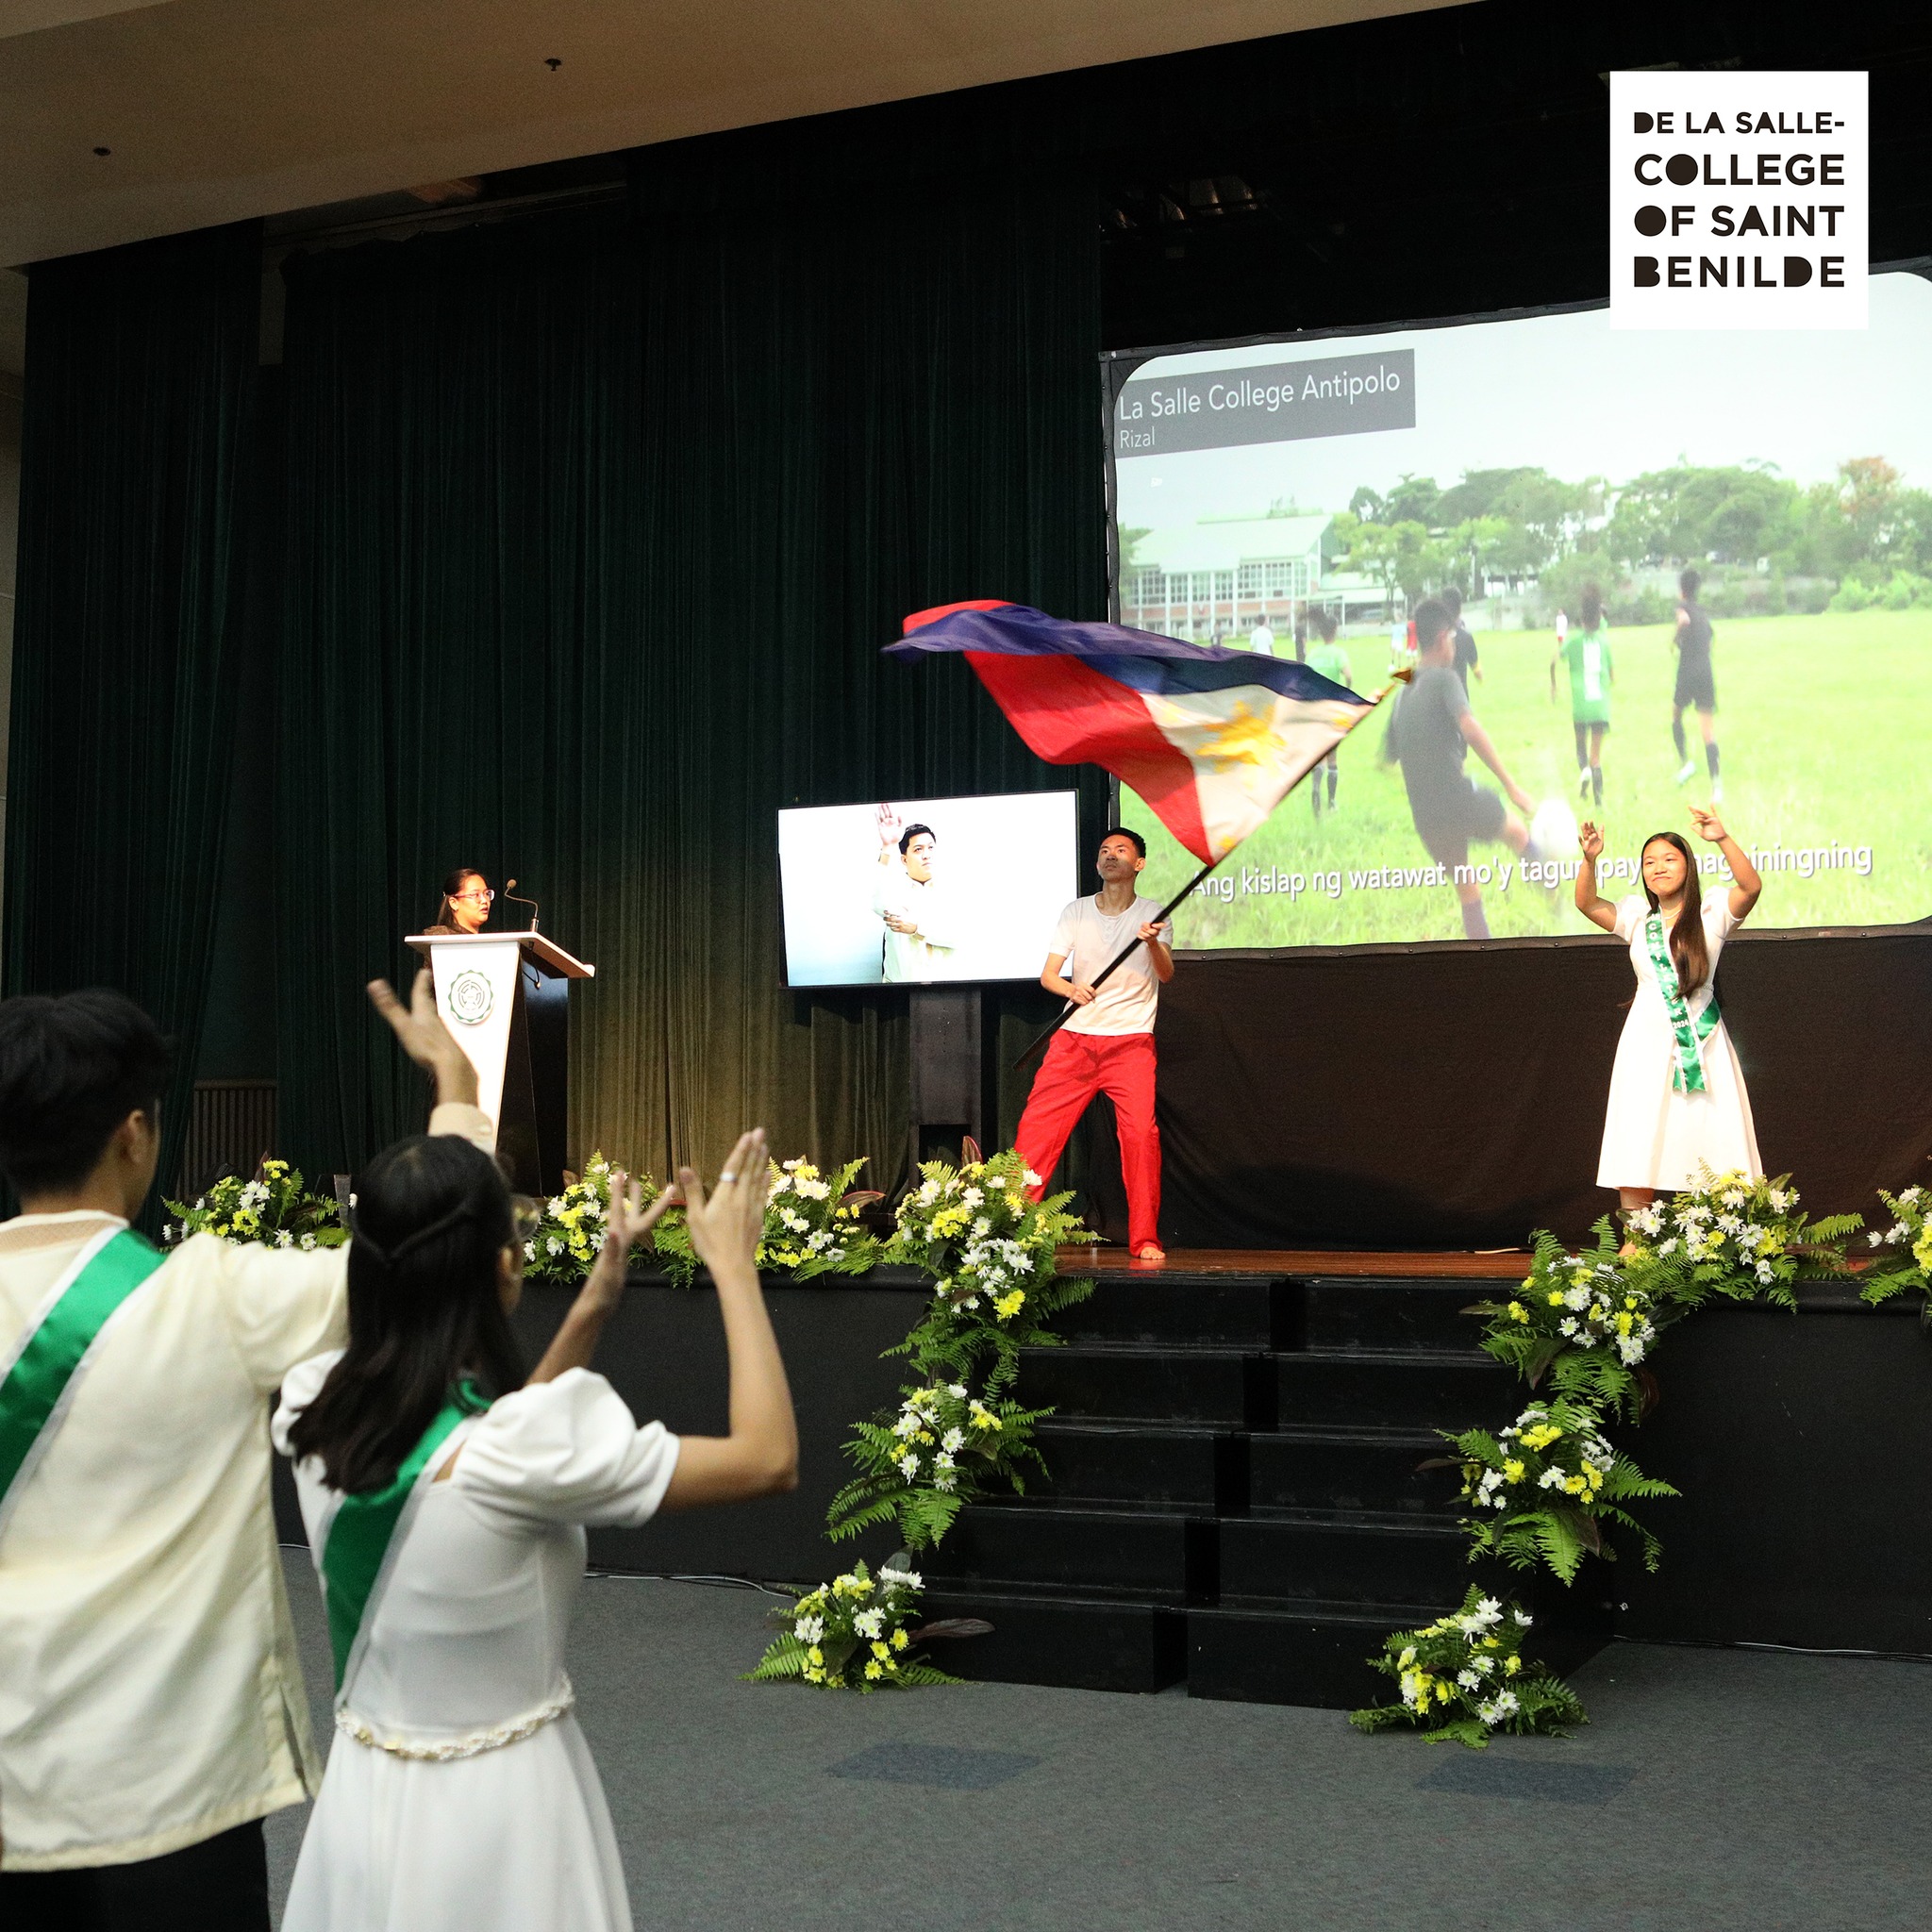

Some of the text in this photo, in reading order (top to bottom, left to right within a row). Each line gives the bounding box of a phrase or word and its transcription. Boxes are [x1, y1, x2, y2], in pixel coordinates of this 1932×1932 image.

[1120, 364, 1401, 421] La Salle College Antipolo
[1120, 425, 1156, 449] Rizal
[1188, 839, 1874, 903] Ang kislap ng watawat mo'y tagupay aginingning
[1672, 1019, 1690, 1029] 2024
